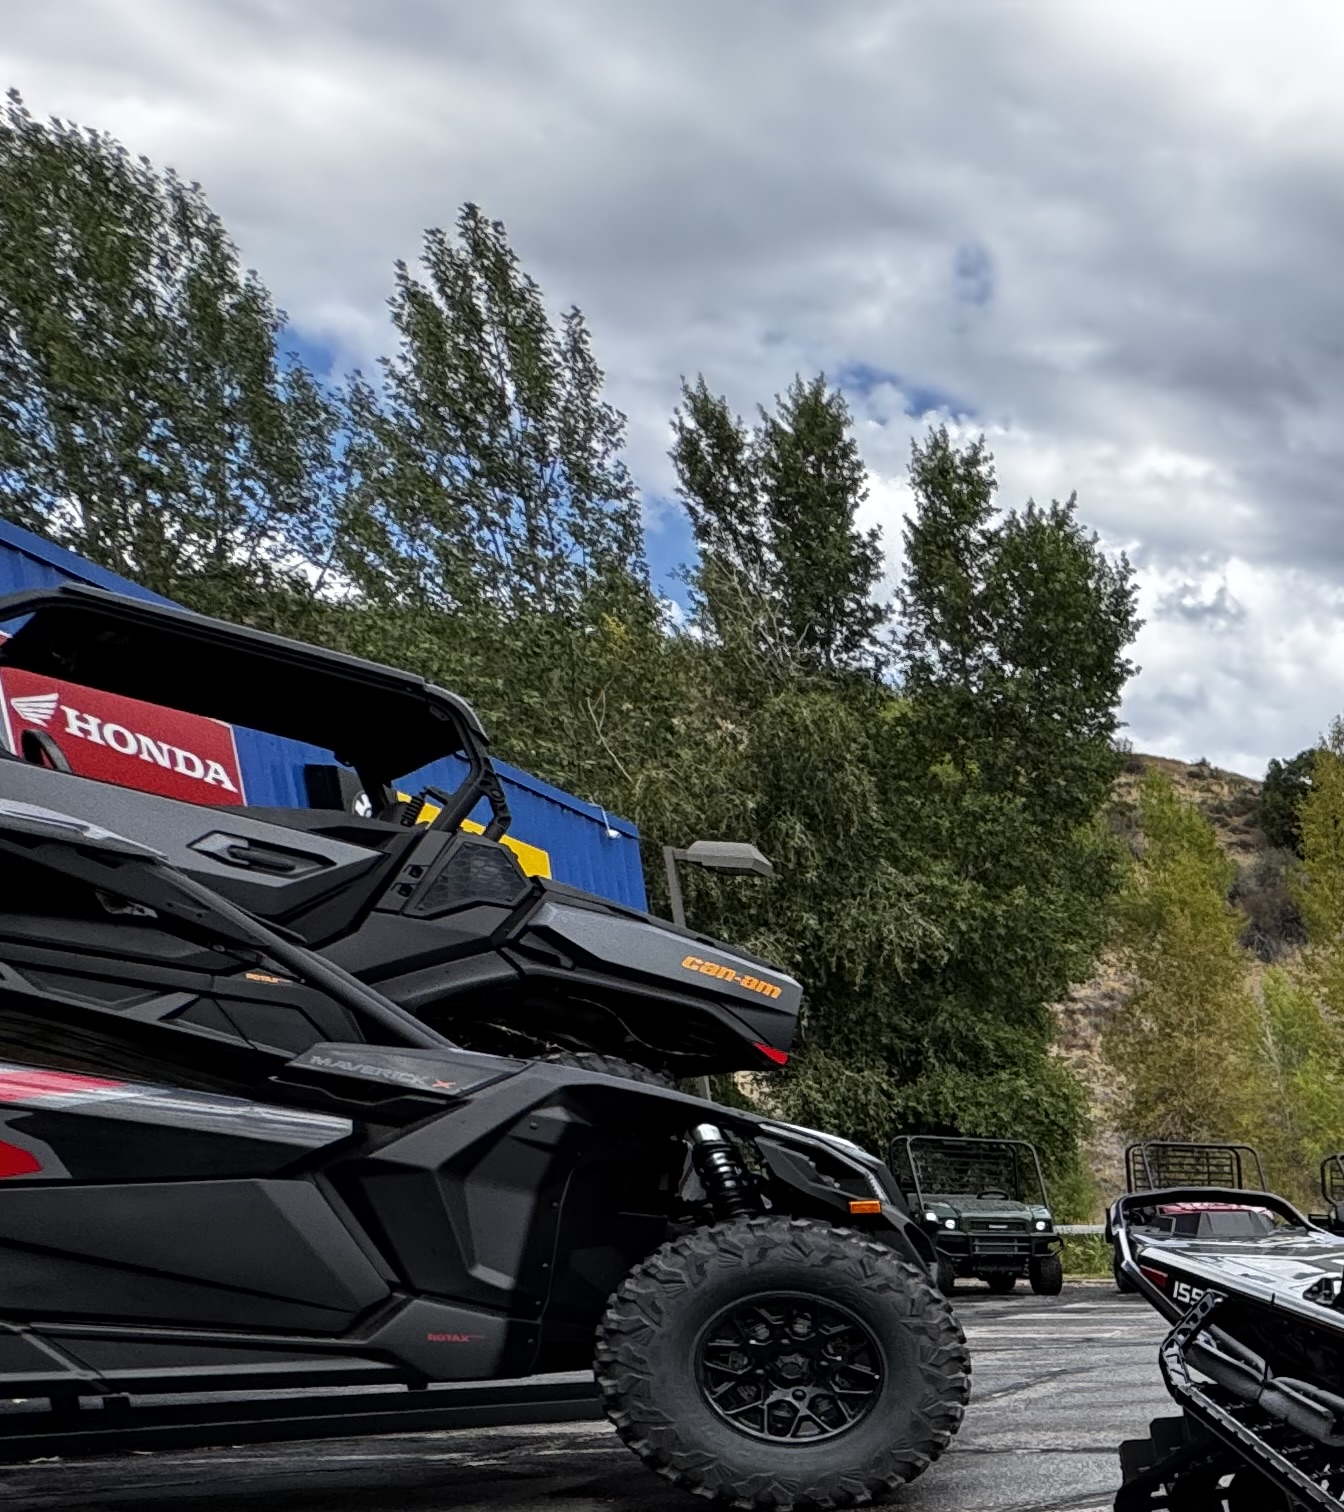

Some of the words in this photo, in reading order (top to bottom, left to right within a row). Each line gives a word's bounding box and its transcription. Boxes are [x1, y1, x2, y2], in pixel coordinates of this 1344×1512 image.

[60, 705, 238, 793] HONDA
[681, 956, 782, 999] can-am
[310, 1056, 430, 1085] MAVERICK
